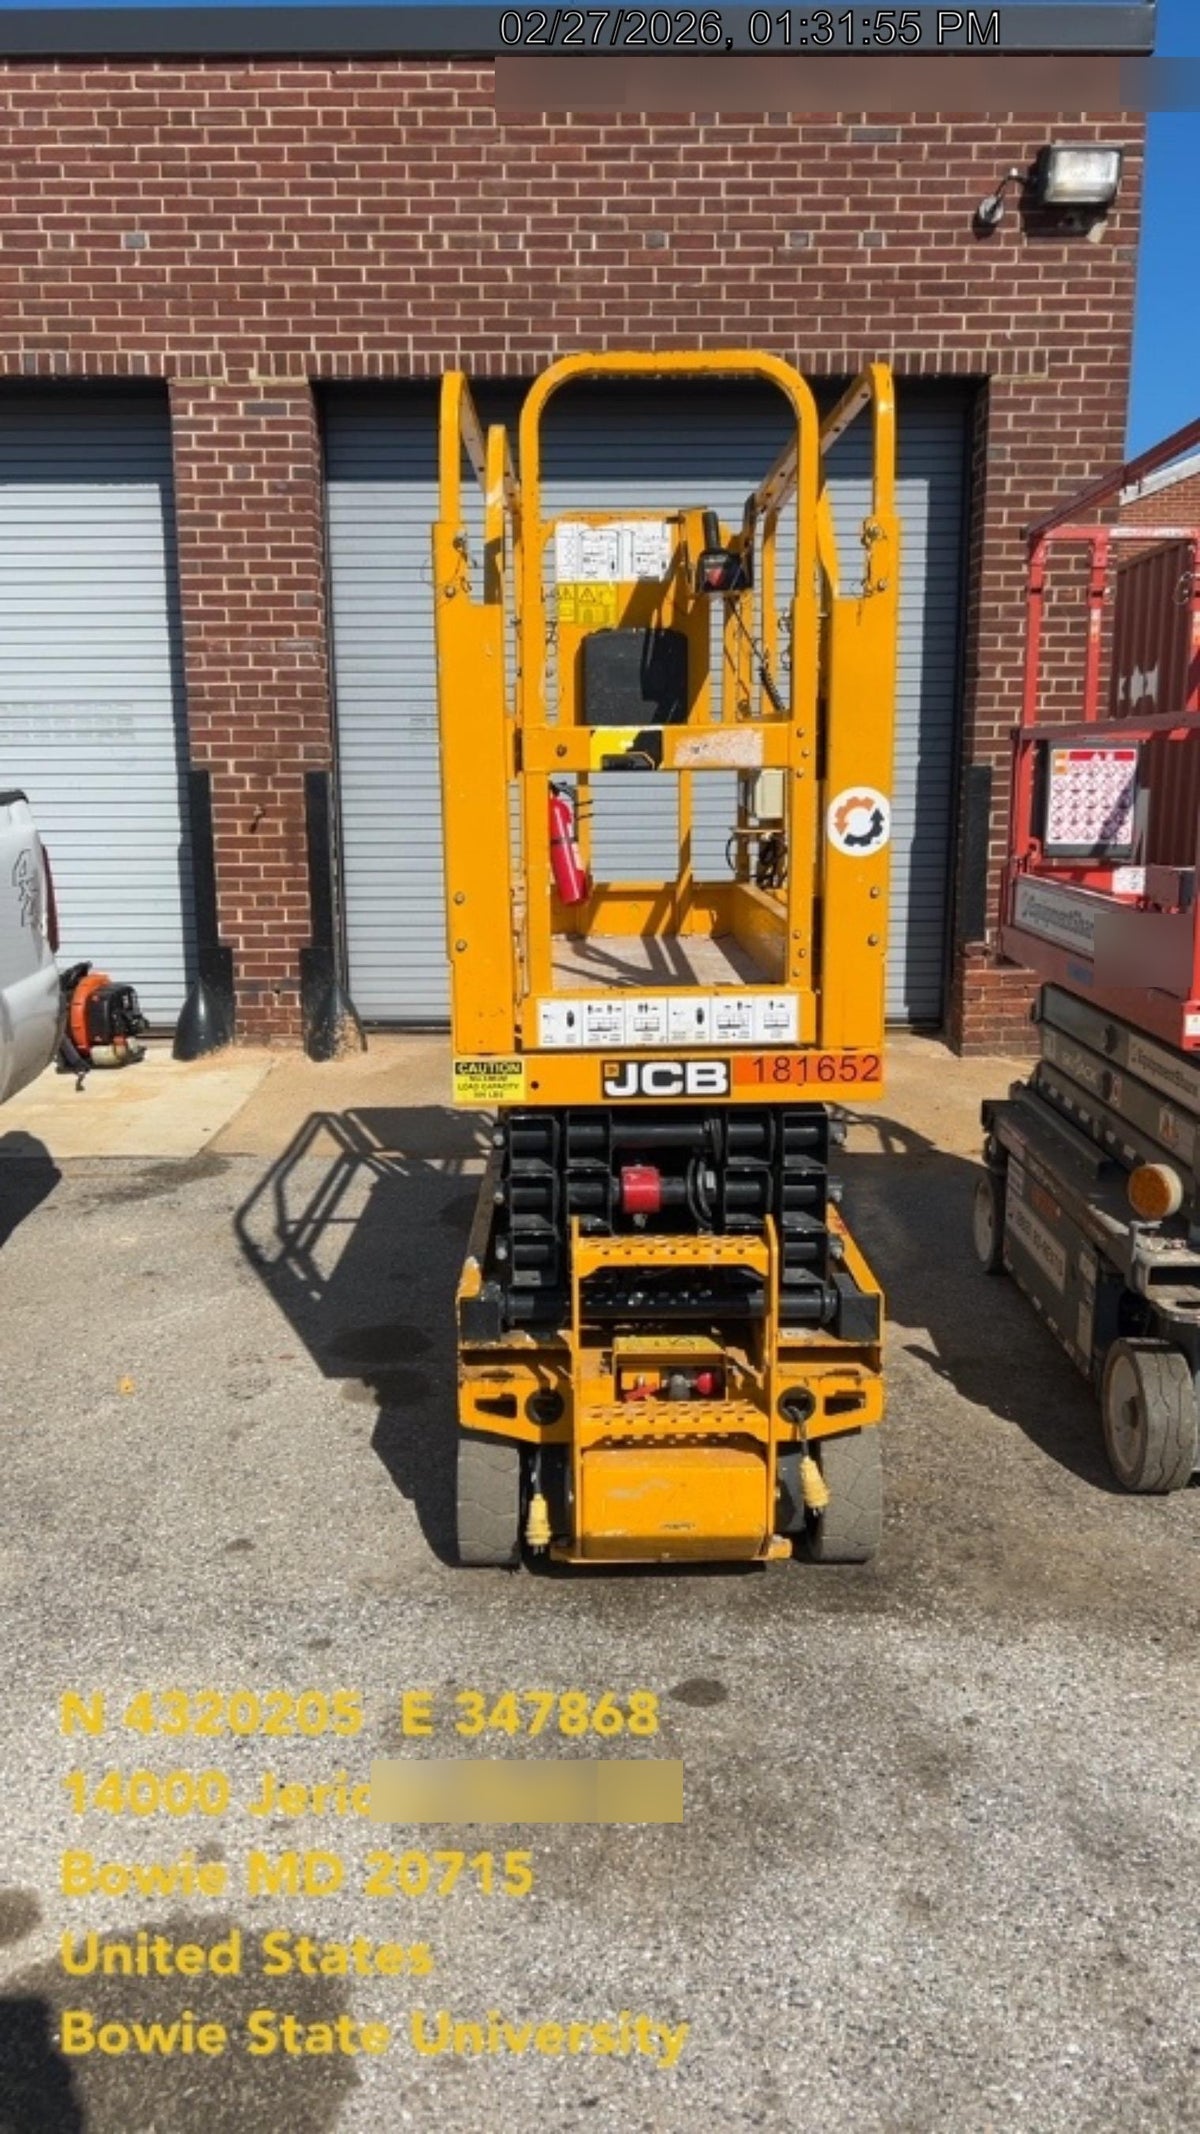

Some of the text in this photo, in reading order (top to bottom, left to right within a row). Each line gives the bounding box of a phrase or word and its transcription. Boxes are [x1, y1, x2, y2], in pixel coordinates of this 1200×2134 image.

[456, 1062, 520, 1074] CAUTION
[603, 1061, 729, 1097] JCB
[751, 1054, 880, 1087] 181652
